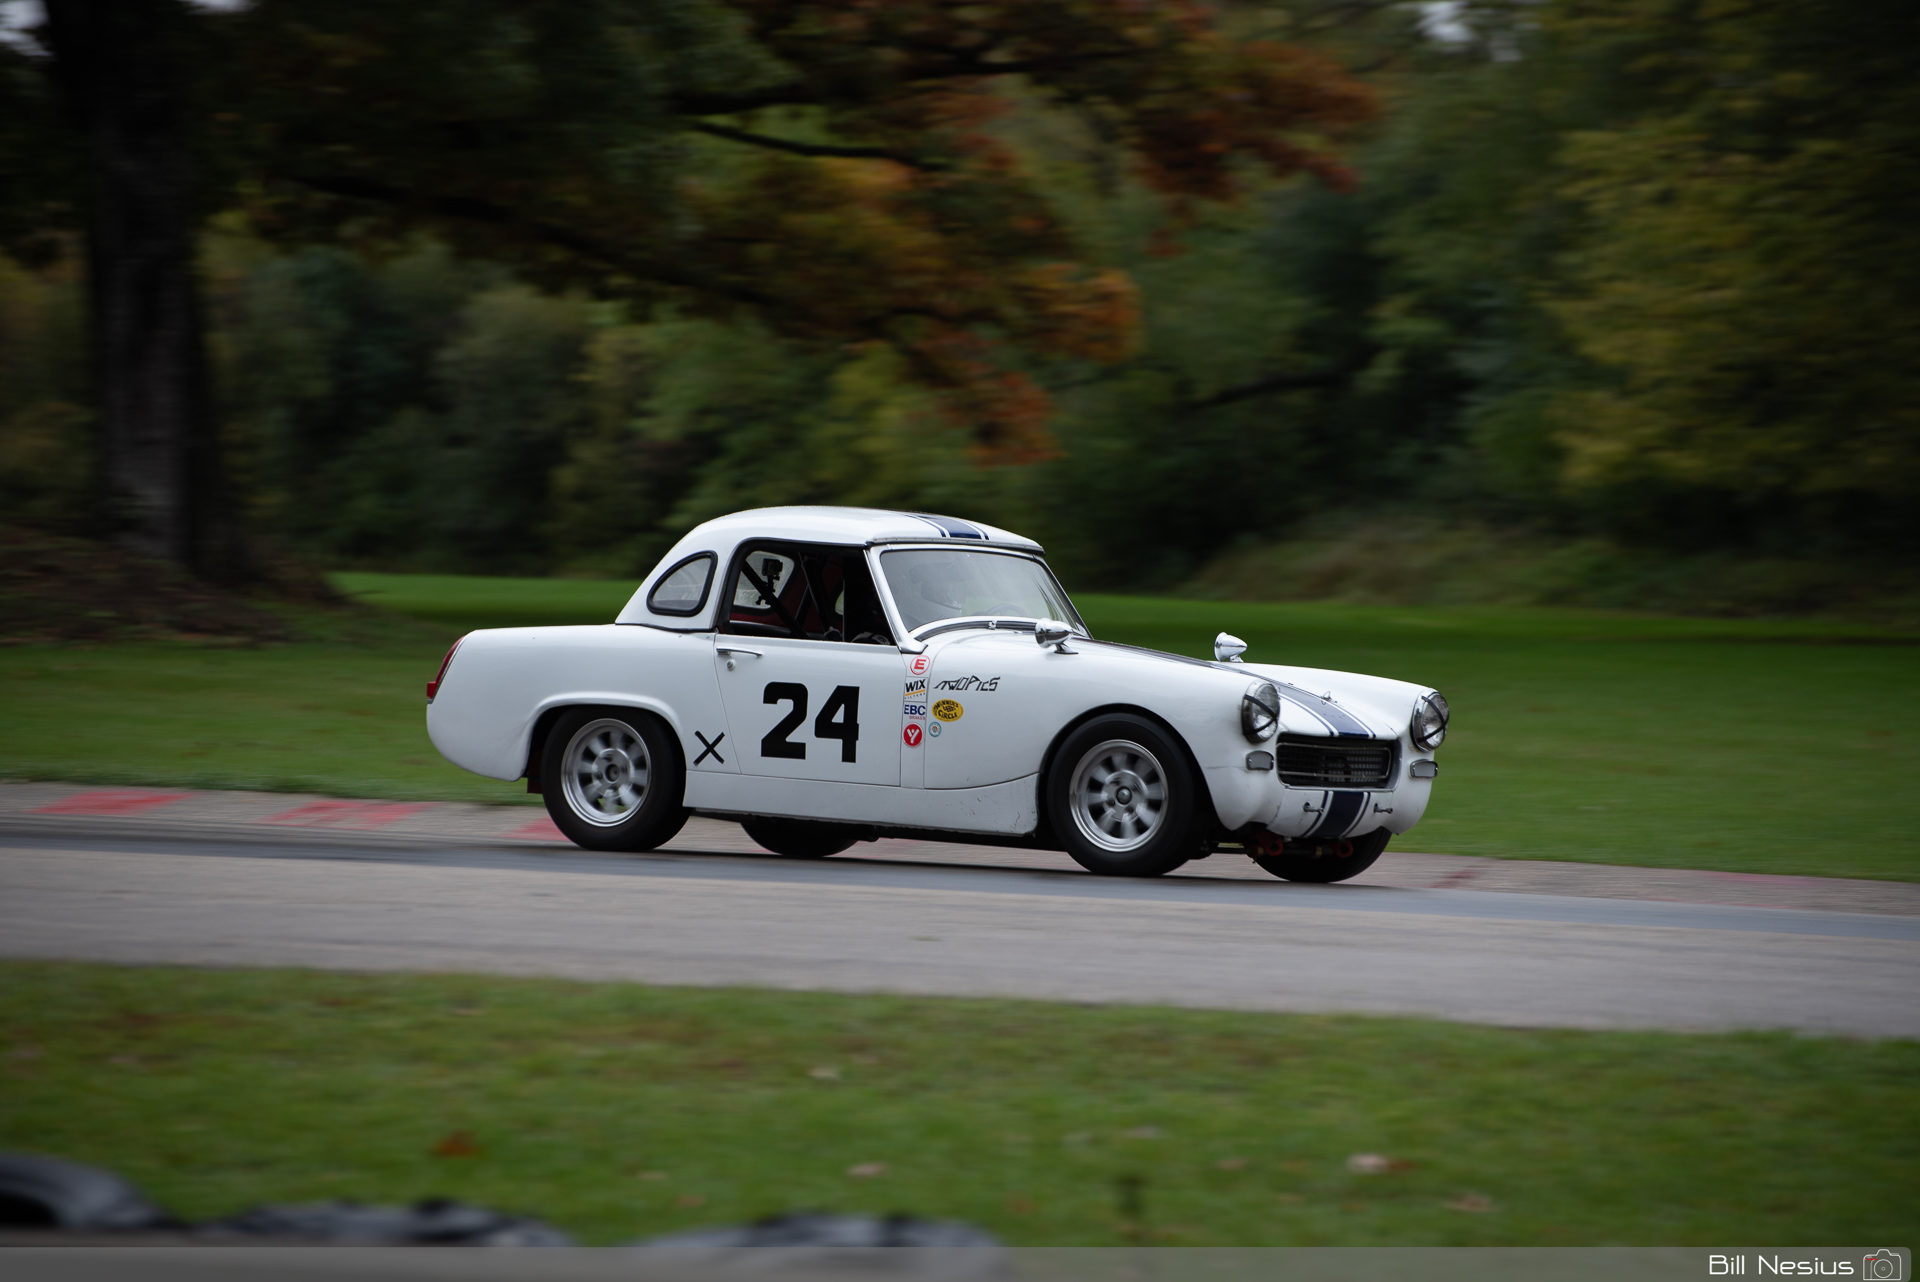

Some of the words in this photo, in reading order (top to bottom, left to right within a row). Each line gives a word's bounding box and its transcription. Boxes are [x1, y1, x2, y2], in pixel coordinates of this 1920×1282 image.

[913, 659, 927, 670] E
[905, 679, 926, 692] WIX
[904, 704, 926, 716] EBC
[760, 681, 860, 763] 24
[693, 730, 726, 767] X
